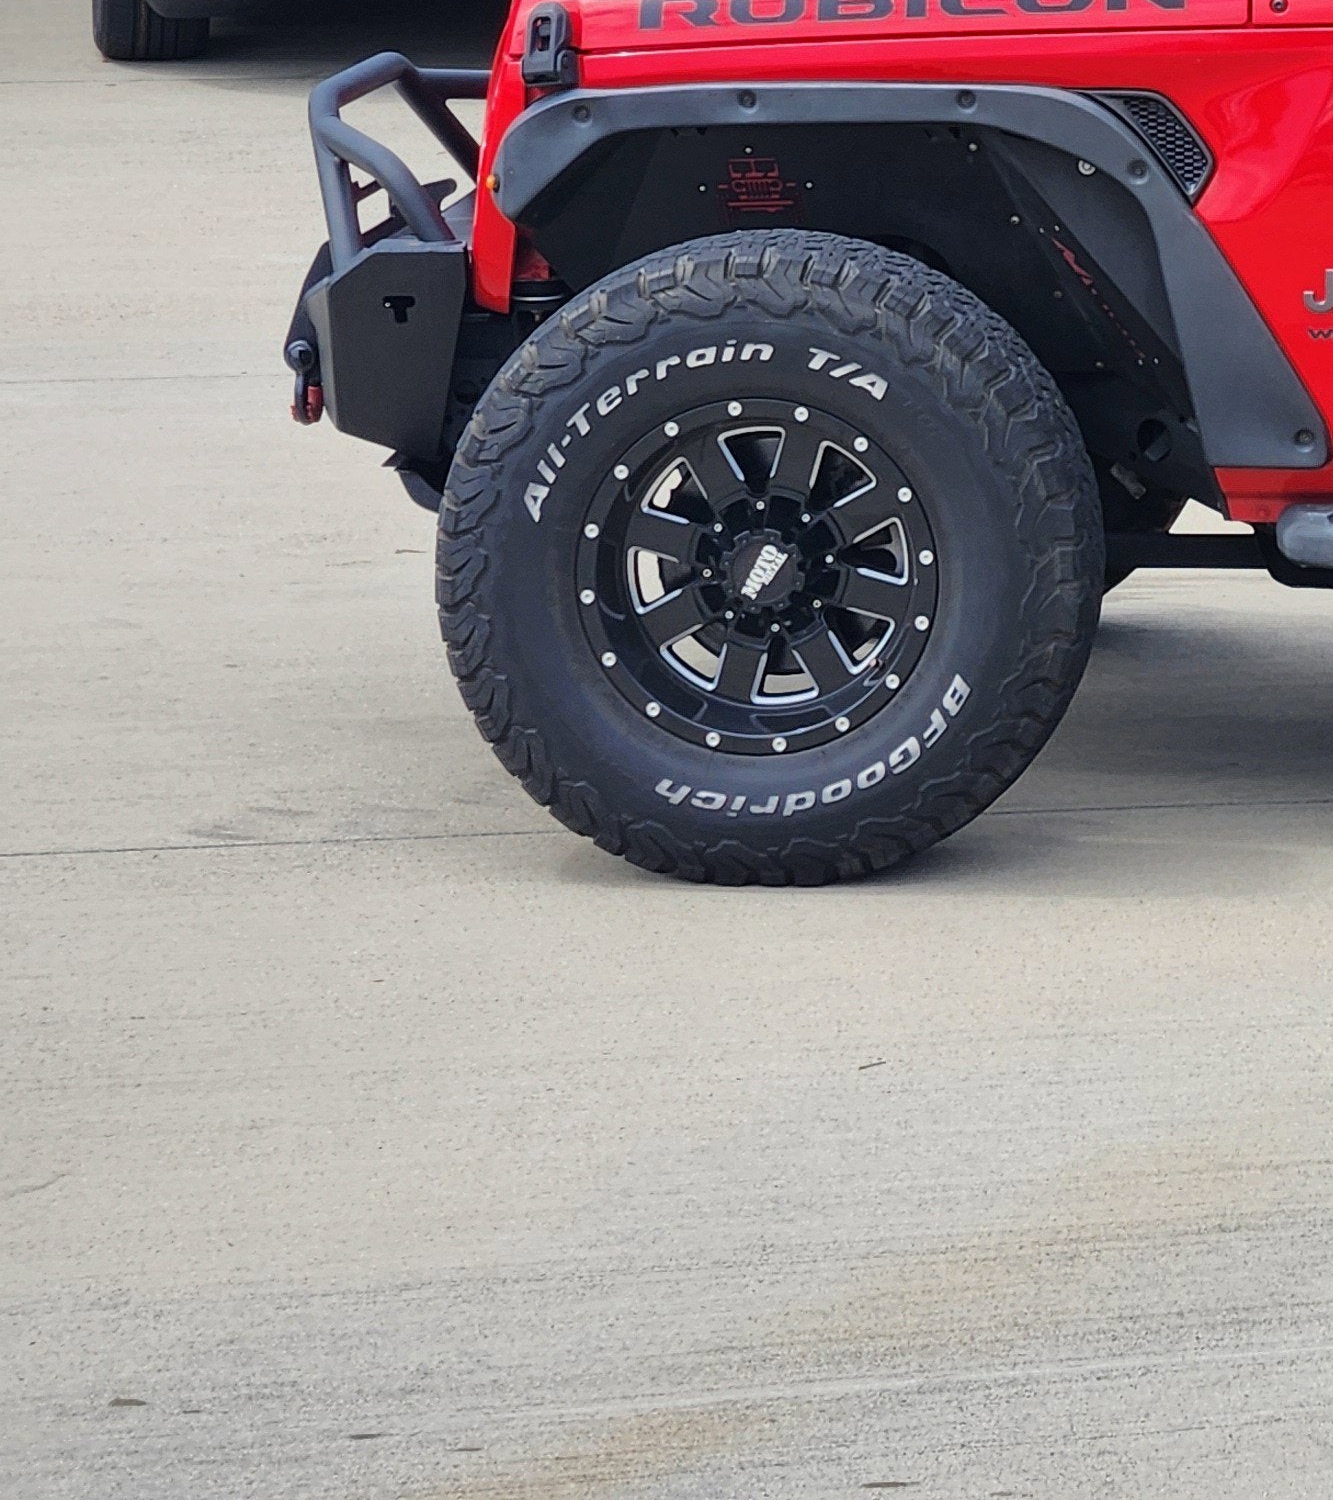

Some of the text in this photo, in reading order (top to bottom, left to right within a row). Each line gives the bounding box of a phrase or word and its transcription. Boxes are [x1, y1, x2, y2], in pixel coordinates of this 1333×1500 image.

[523, 338, 890, 523] All-Terrain T/A
[740, 544, 778, 601] MOTO
[654, 673, 972, 817] BFGoodrich
